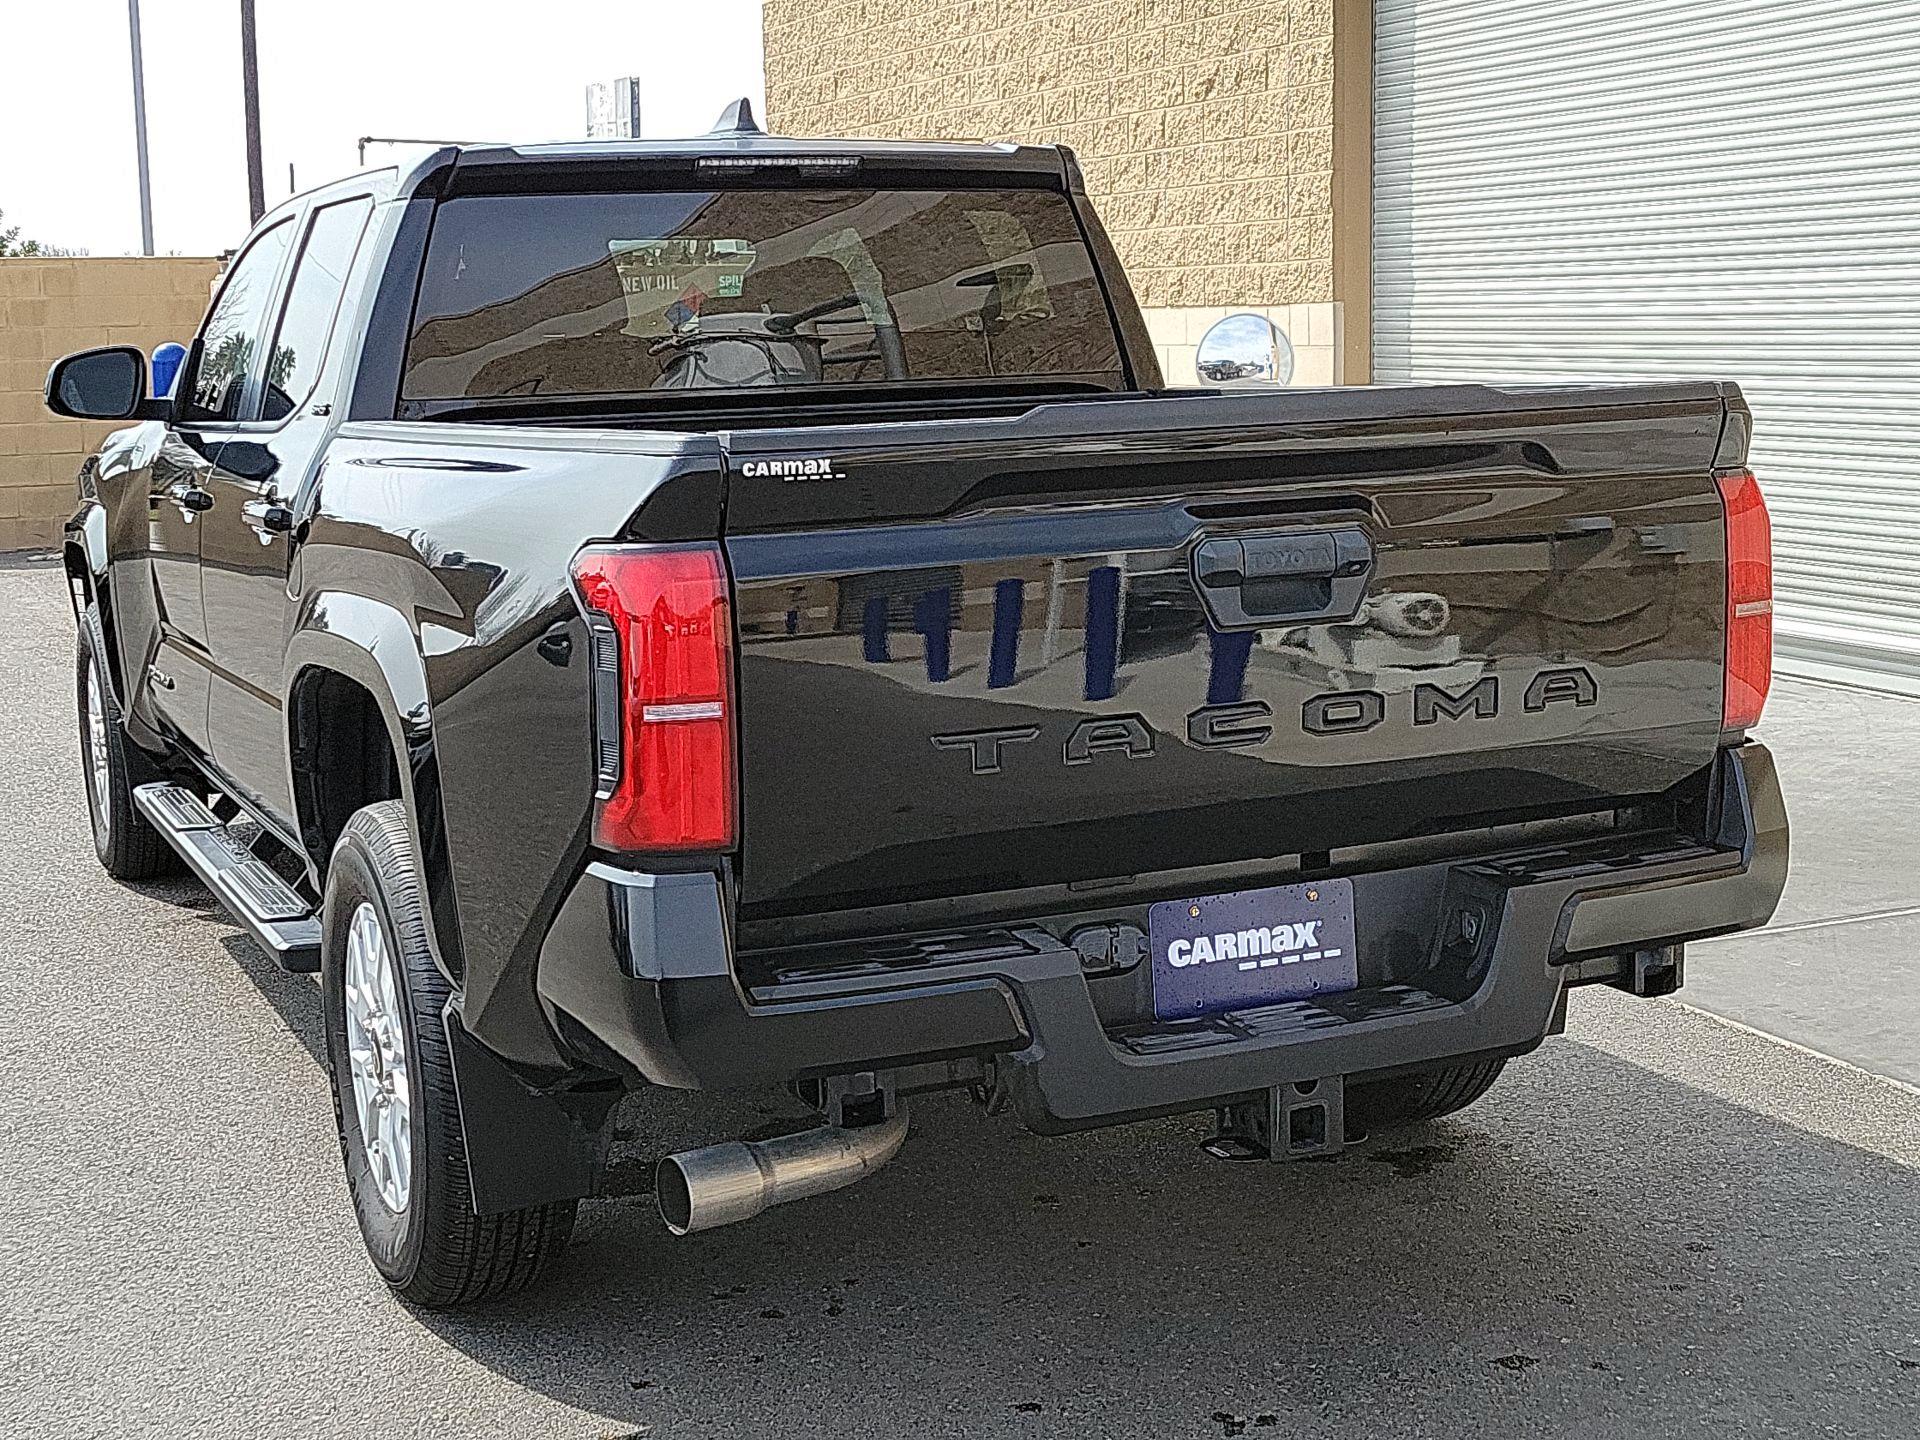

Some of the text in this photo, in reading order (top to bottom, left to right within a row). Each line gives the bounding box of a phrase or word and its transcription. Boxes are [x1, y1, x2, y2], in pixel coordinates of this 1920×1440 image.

[622, 274, 679, 293] NEW OIL
[1247, 547, 1333, 569] TOYOTA
[930, 666, 1599, 775] TACOMA
